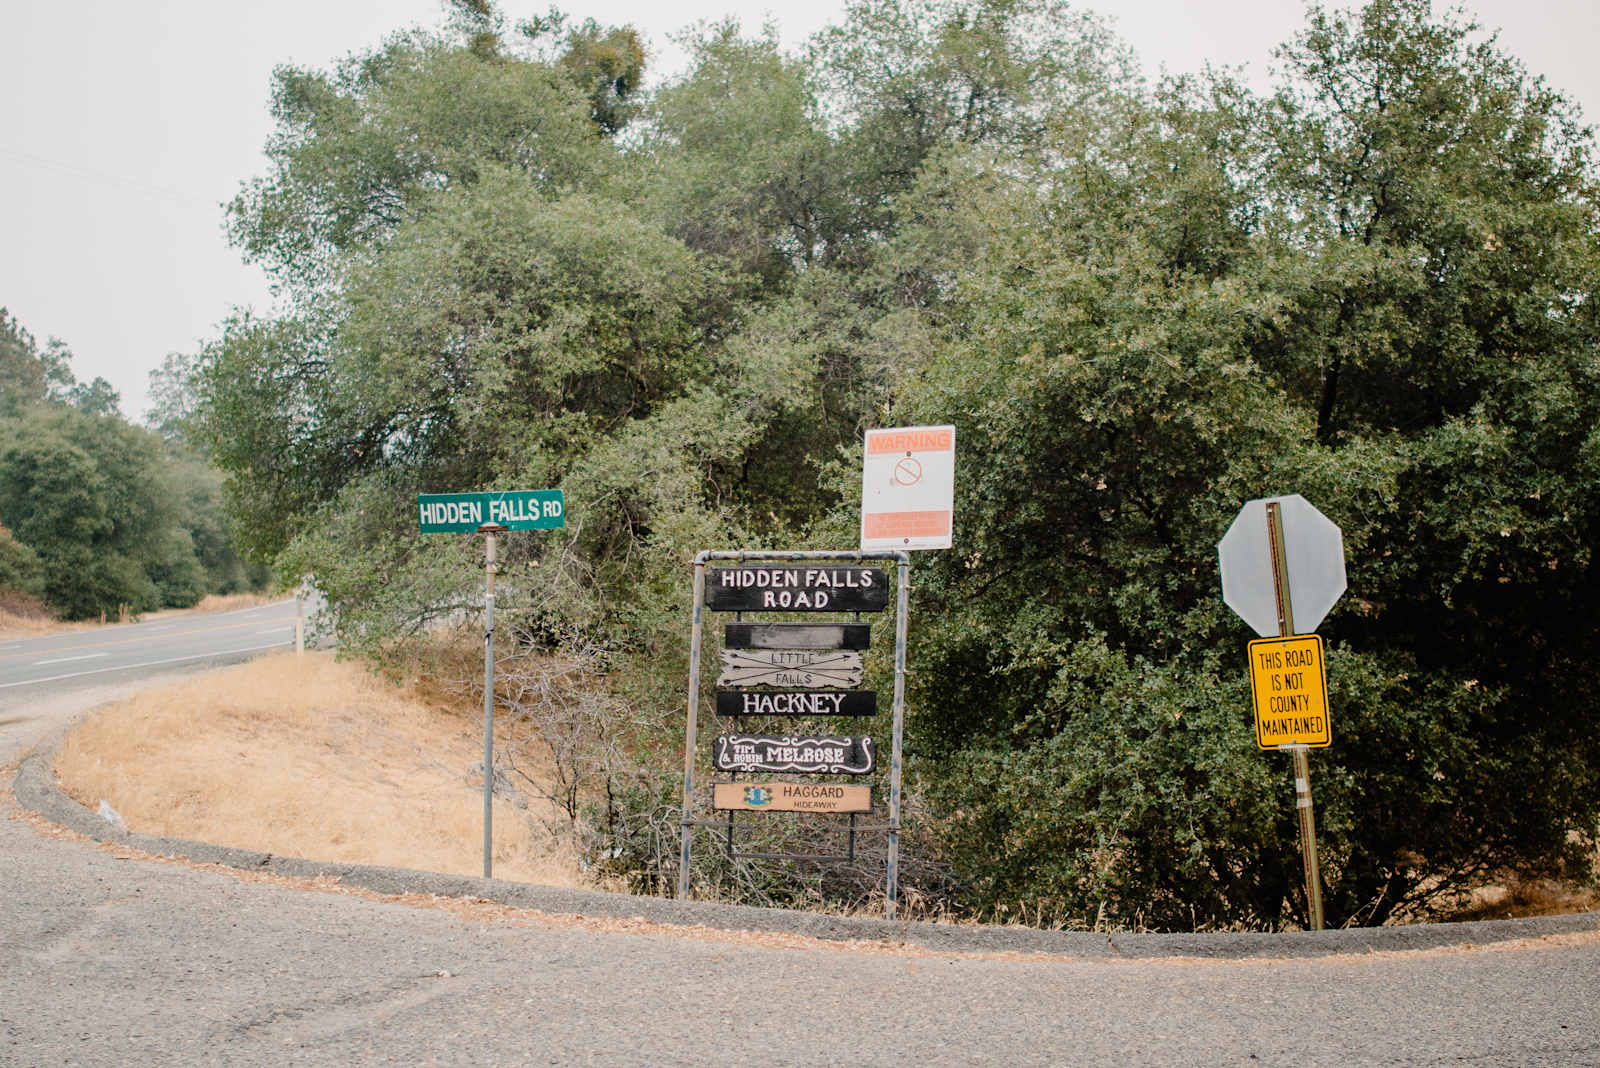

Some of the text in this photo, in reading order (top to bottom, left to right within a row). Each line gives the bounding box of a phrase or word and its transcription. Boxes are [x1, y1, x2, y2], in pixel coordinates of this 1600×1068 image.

[868, 431, 951, 450] WARNING
[420, 498, 562, 525] HIDDEN FALLS RD
[721, 569, 873, 588] HIDDEN FALLS
[763, 590, 829, 608] ROAD
[771, 653, 815, 665] LITTLE
[1259, 649, 1314, 670] THIS ROAD
[775, 673, 813, 685] FALLS
[1271, 672, 1304, 691] IS NOT
[742, 693, 847, 713] HACKNEY
[1270, 694, 1310, 713] COUNTY
[1262, 716, 1323, 737] MAINTAINED
[722, 753, 764, 763] & ROBIN
[733, 744, 756, 754] TIM
[766, 746, 845, 763] MELROSE
[783, 786, 845, 799] HAGGARD
[793, 801, 837, 809] HIDEAWAY
